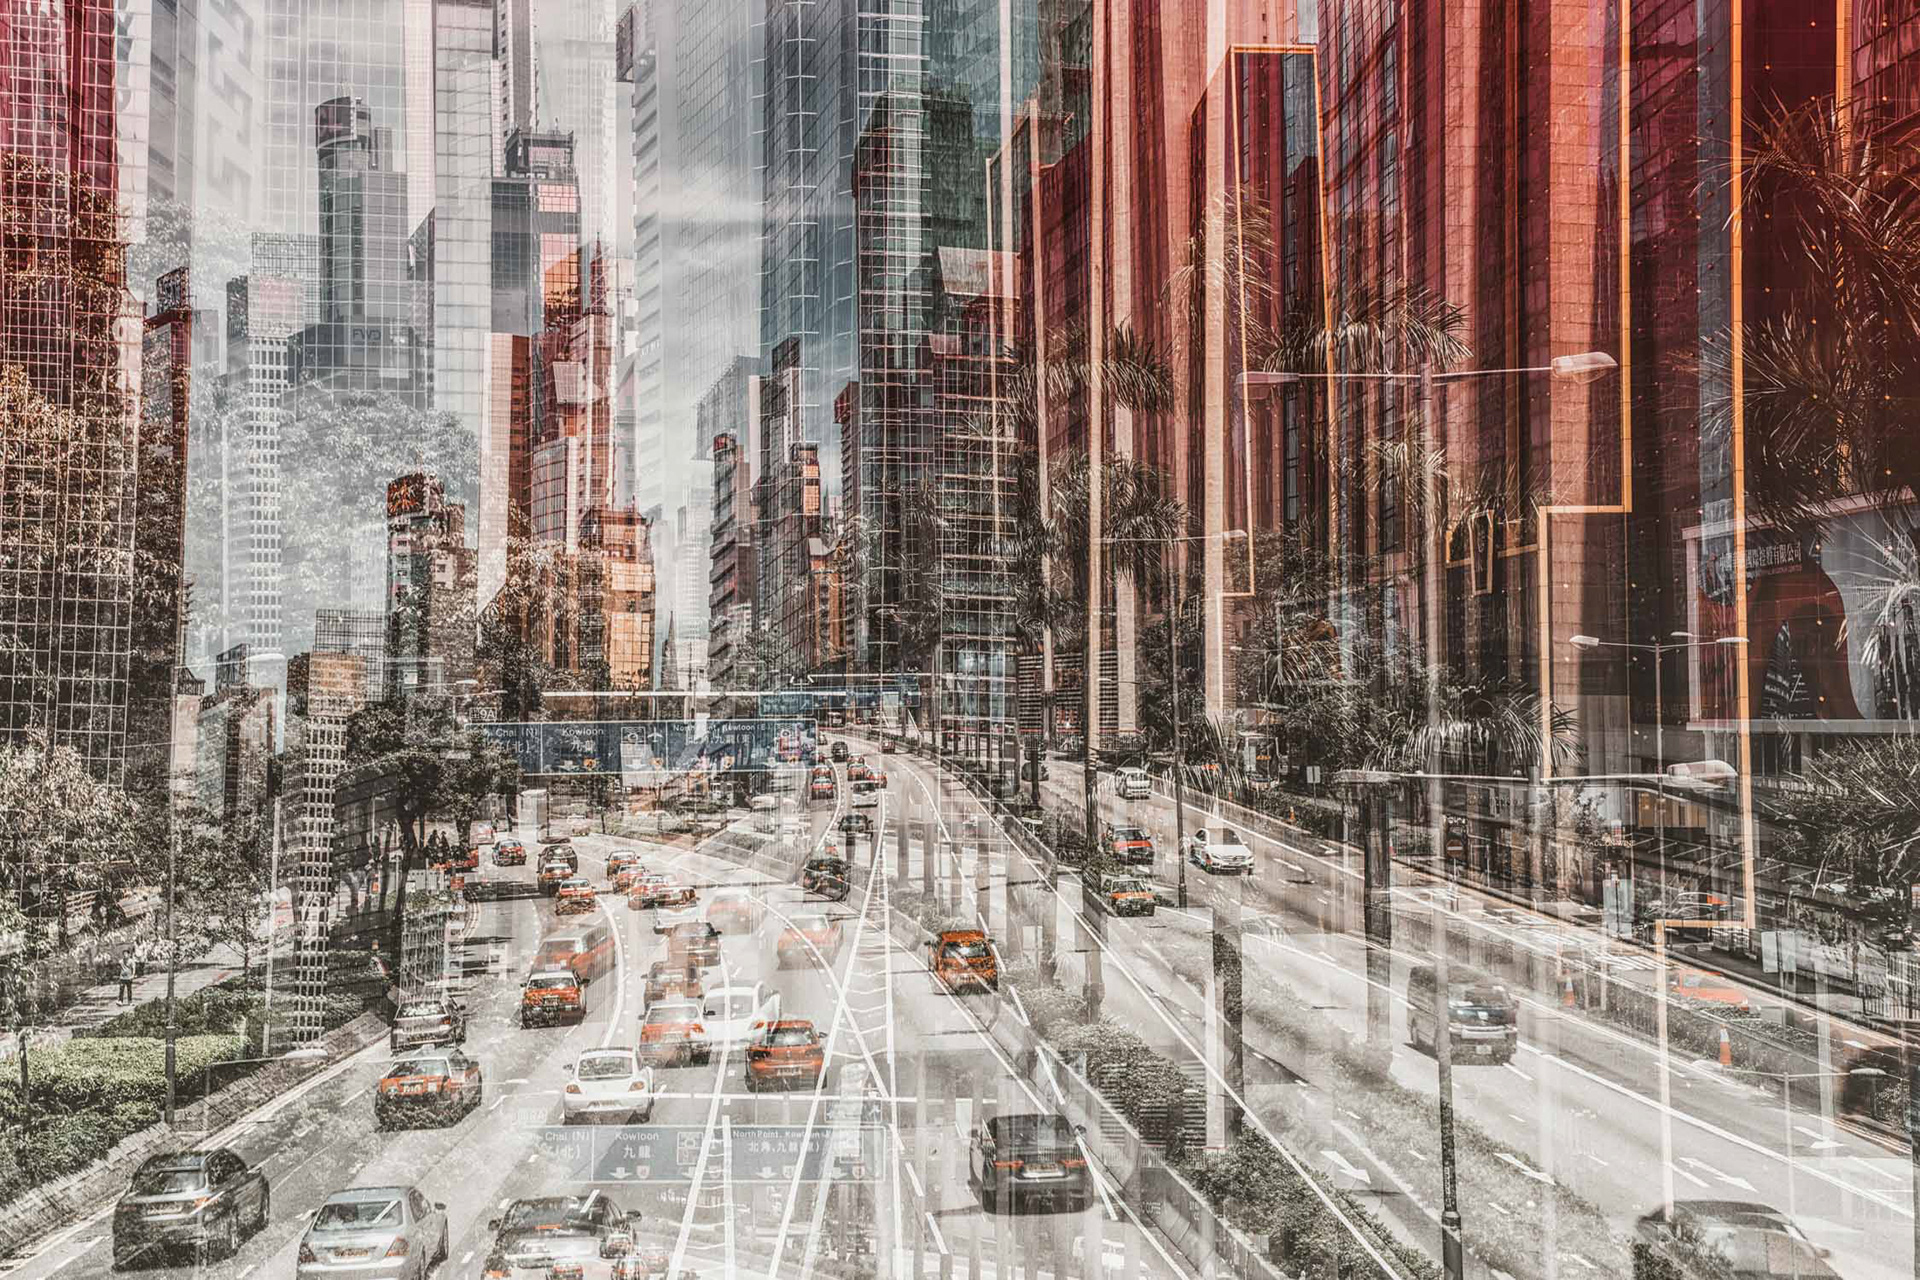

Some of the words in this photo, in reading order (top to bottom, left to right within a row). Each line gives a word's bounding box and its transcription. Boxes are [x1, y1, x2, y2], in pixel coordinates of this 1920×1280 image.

[353, 328, 381, 341] FWD
[480, 709, 495, 719] 9A
[562, 727, 604, 738] Kowloon
[615, 1131, 659, 1141] Kowloon
[733, 1131, 756, 1139] North
